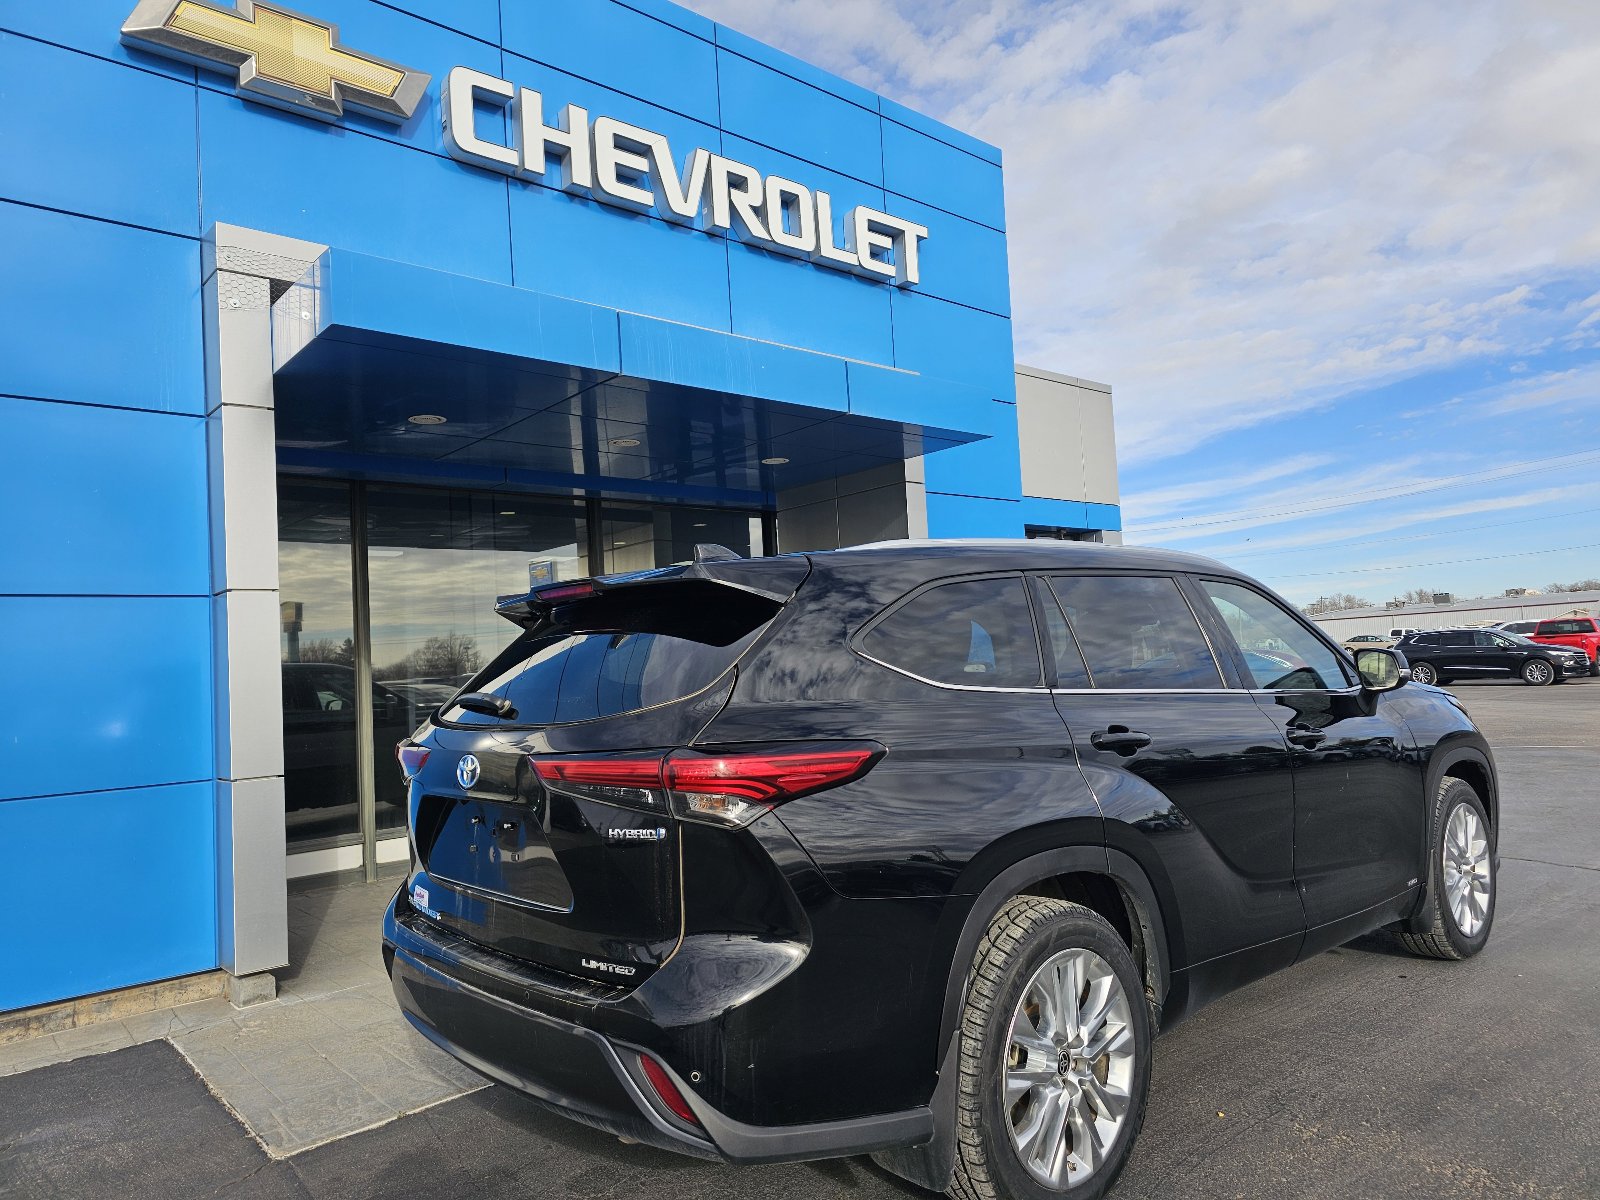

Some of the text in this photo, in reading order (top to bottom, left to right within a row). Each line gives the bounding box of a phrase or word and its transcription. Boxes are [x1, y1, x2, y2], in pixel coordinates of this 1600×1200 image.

[442, 66, 928, 287] CHEVROLET
[608, 828, 657, 839] HYBRID
[581, 958, 636, 976] LIMITED
